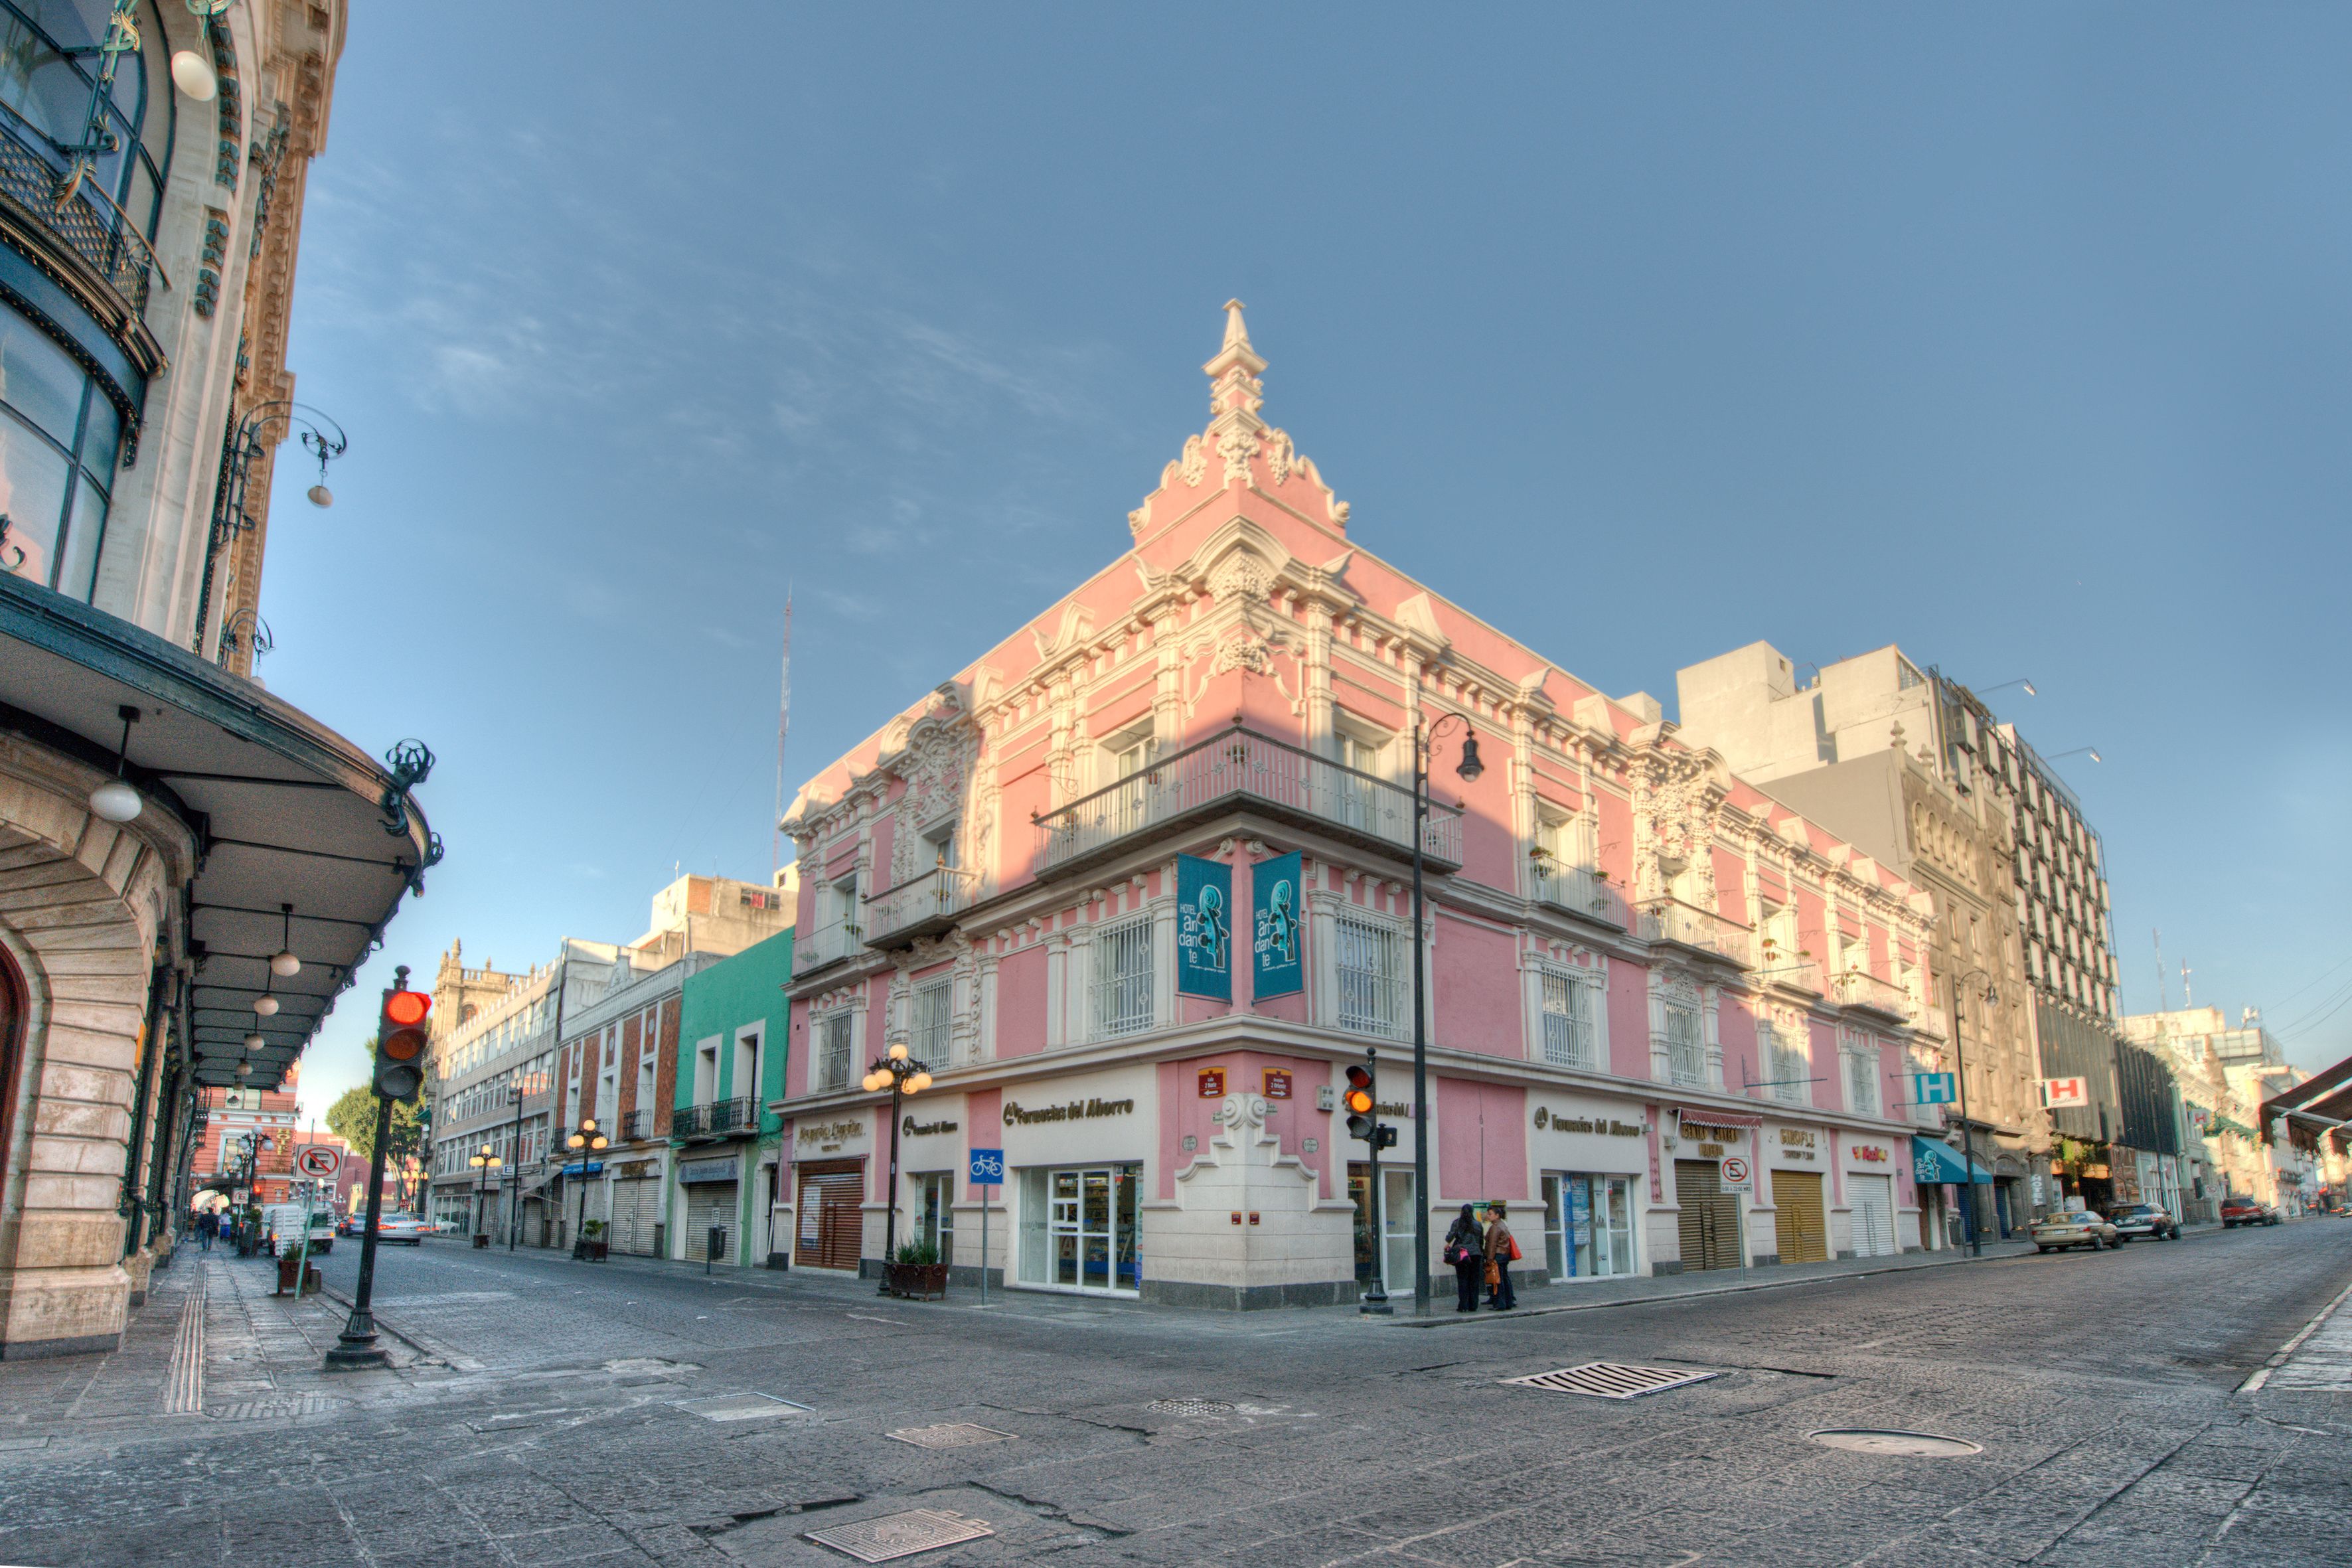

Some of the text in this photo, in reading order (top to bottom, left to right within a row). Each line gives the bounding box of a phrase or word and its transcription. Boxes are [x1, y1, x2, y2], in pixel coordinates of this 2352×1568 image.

[1180, 903, 1196, 915] HOTEL
[1256, 908, 1268, 921] HOTEL
[1184, 915, 1198, 932] an
[1258, 921, 1270, 937] an
[1178, 931, 1198, 948] dan
[1254, 937, 1270, 953] dan
[1188, 948, 1198, 964] te
[1262, 952, 1271, 967] te
[1921, 1075, 1950, 1103] H
[2051, 1079, 2078, 1099] H
[1017, 1103, 1067, 1125] Farmacias
[1067, 1100, 1084, 1121] del
[1085, 1097, 1134, 1118] Ahorro
[1551, 1114, 1593, 1133] Farmacias
[1595, 1118, 1607, 1134] del
